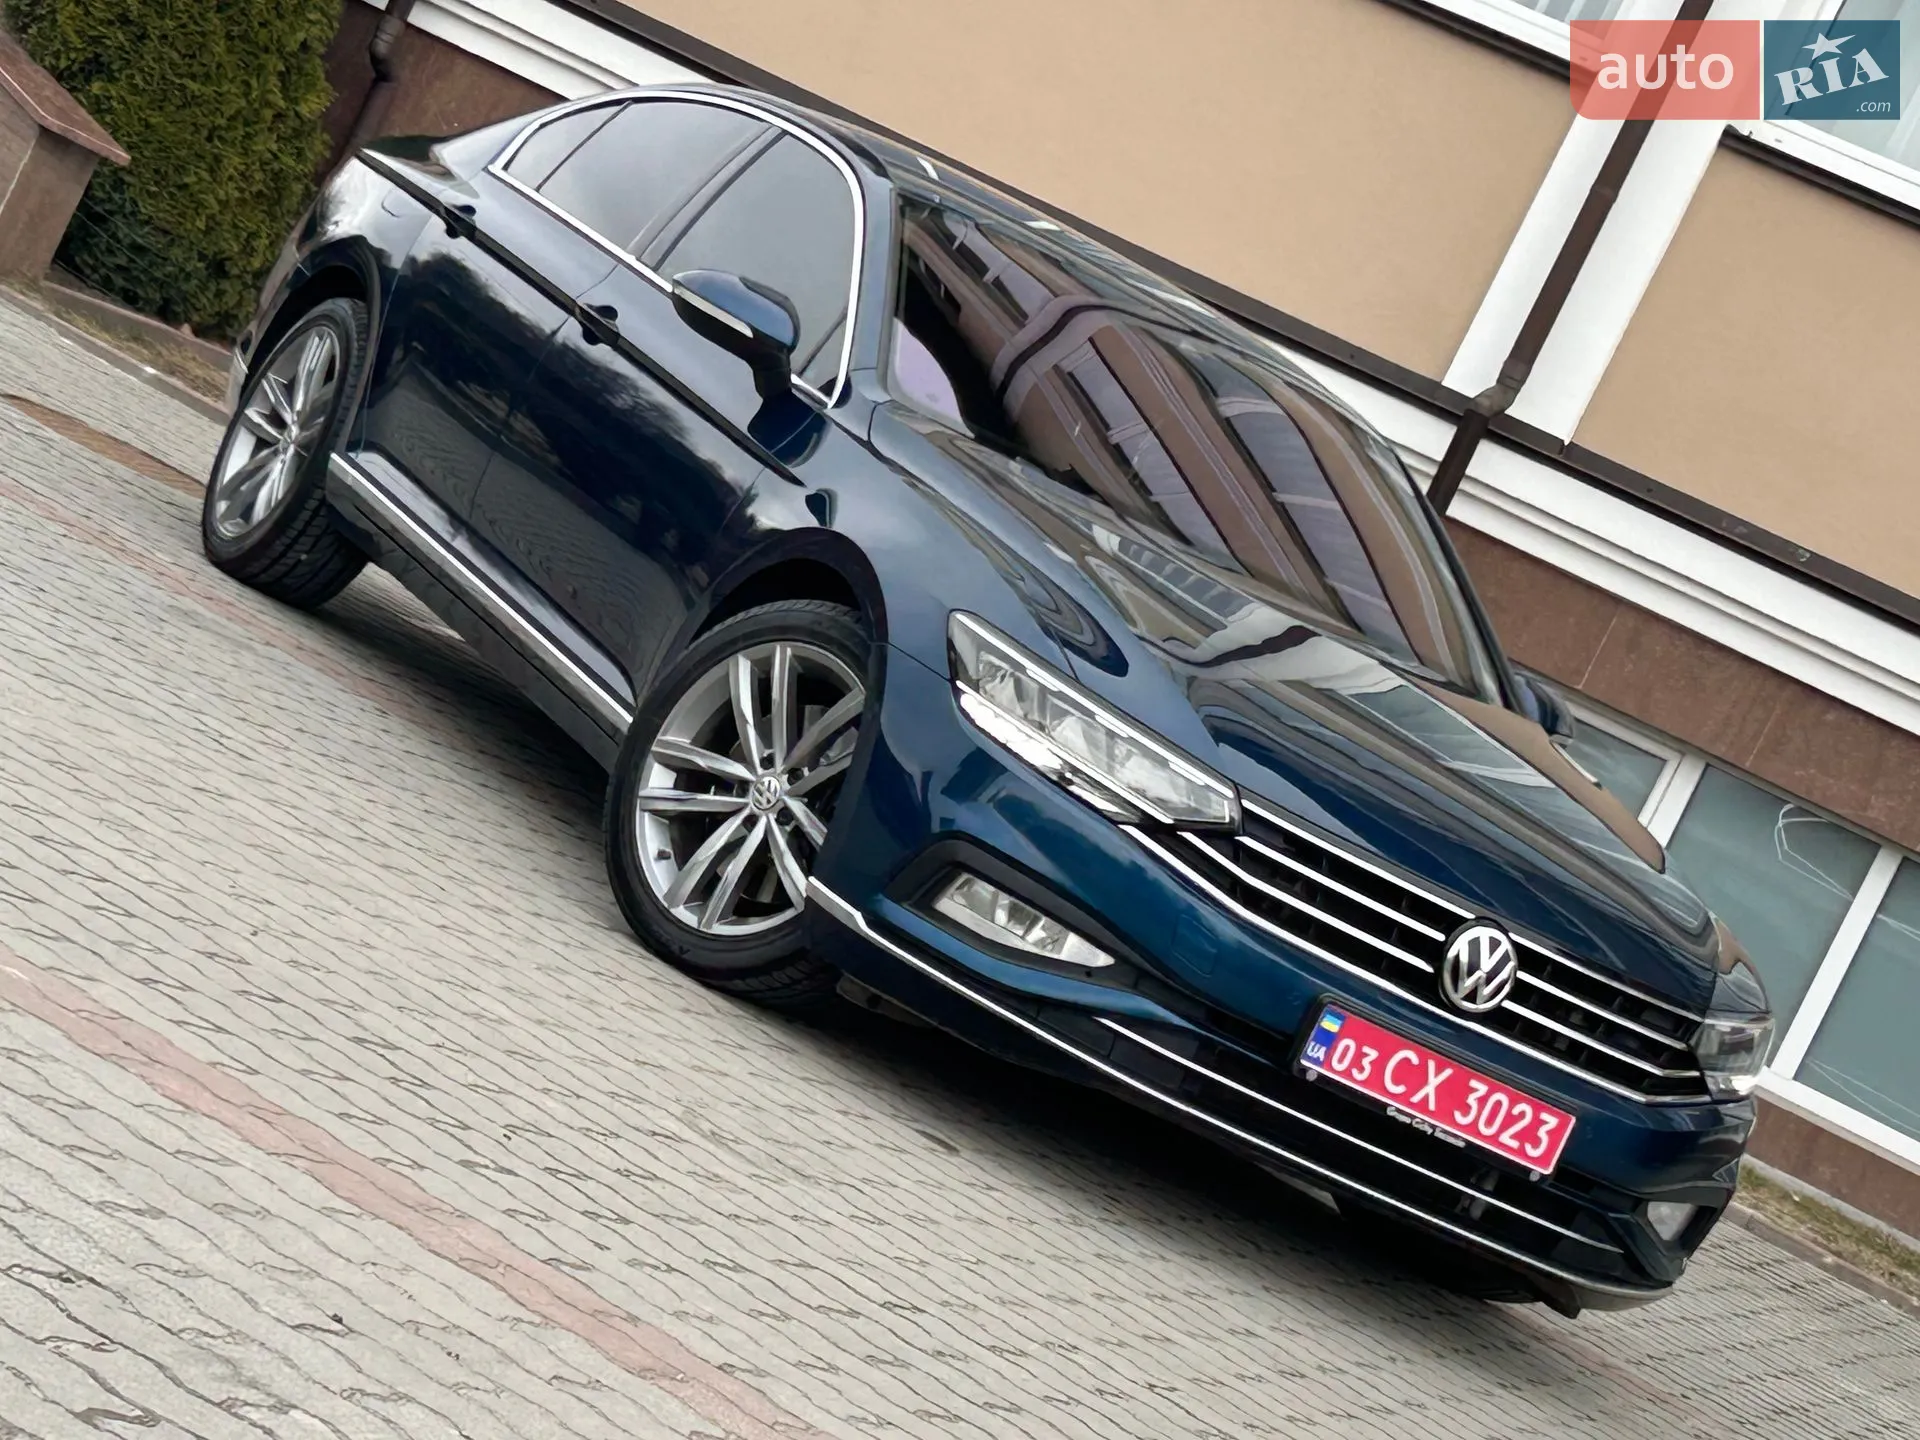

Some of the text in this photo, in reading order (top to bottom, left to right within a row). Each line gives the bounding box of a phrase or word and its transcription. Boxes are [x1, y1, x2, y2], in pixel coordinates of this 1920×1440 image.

[1306, 1041, 1327, 1062] UA
[1331, 1038, 1379, 1081] 03
[1384, 1049, 1453, 1112] CX
[1454, 1079, 1559, 1159] 3023
